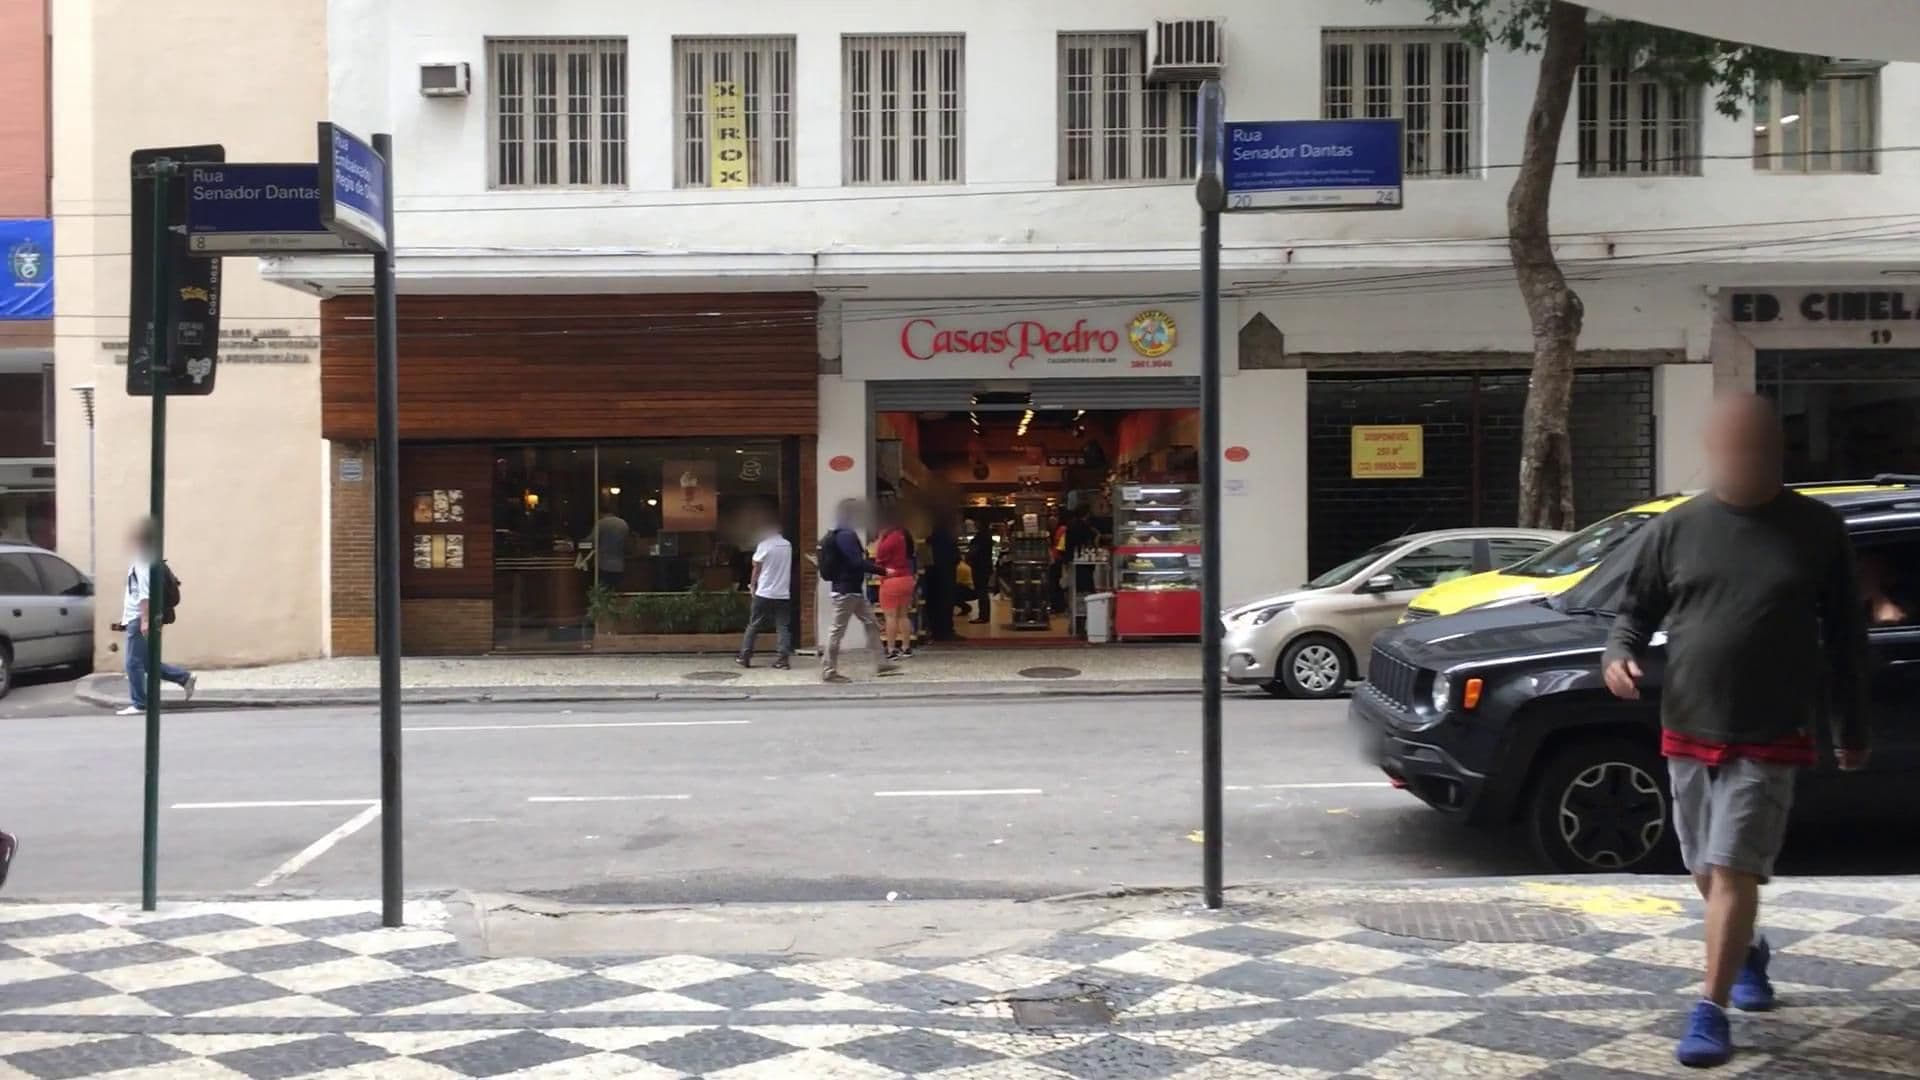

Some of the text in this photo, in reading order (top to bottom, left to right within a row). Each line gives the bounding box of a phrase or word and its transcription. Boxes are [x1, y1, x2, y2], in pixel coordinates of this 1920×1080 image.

[714, 85, 743, 183] XEROX
[1233, 129, 1263, 142] Rua
[1233, 143, 1353, 160] Senador Dantas
[193, 168, 224, 182] Rua
[193, 184, 320, 200] Senador Dantas
[1376, 190, 1394, 204] 24
[1234, 194, 1251, 208] 20
[196, 236, 206, 249] 8
[1870, 329, 1893, 344] 19
[900, 319, 1007, 360] Casas
[1006, 319, 1119, 370] Pedro
